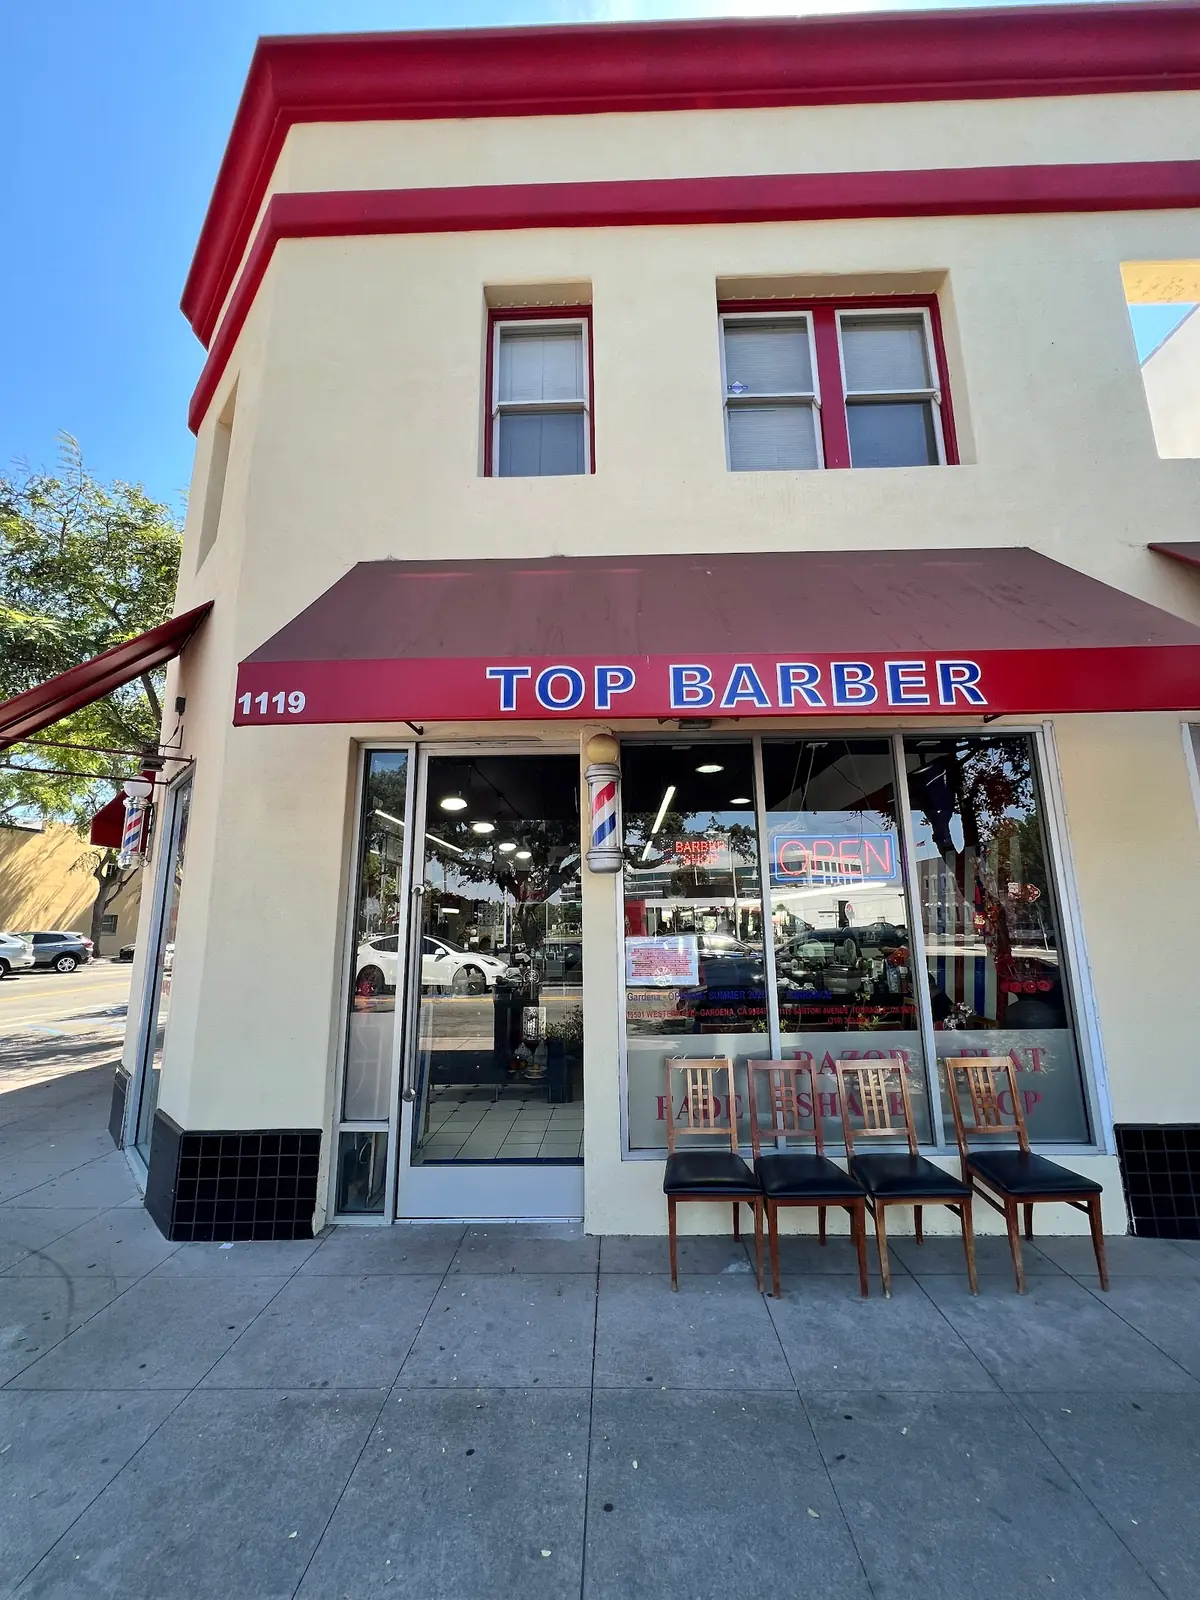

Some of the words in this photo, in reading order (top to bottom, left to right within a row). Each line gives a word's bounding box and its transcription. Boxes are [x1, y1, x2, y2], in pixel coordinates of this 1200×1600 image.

[486, 665, 636, 711] TOP
[669, 660, 988, 709] BARBER
[238, 691, 306, 715] 1119
[779, 839, 890, 876] OPEN
[627, 992, 662, 1002] Gardena
[708, 989, 746, 1000] SUMMER
